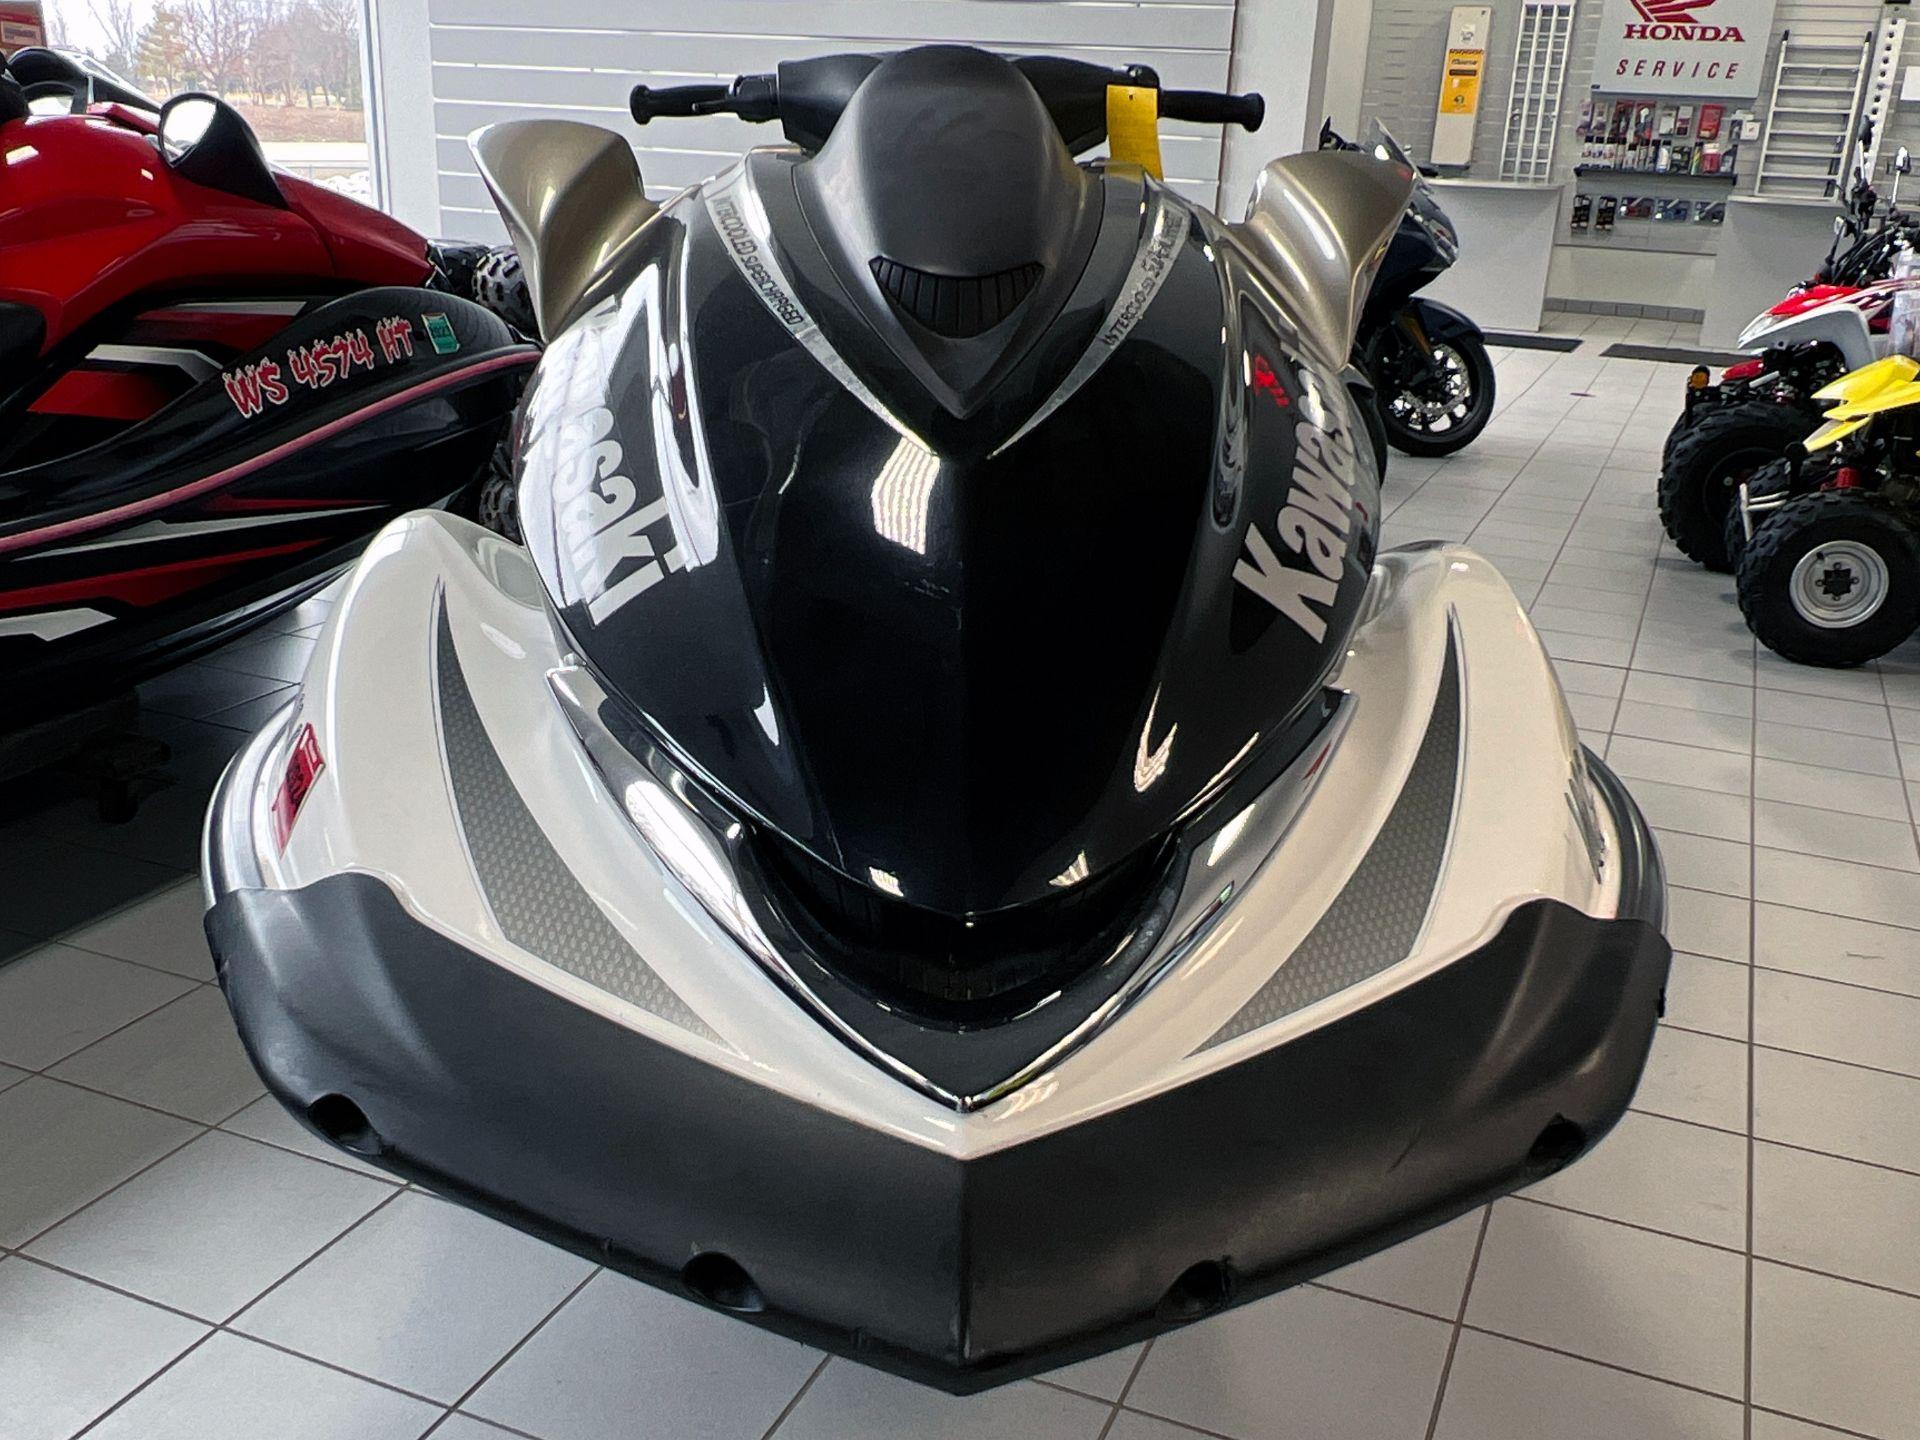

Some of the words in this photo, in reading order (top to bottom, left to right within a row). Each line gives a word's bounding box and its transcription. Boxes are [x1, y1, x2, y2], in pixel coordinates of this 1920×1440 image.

[1623, 24, 1745, 42] HONDA
[1616, 59, 1739, 79] SERVICE
[222, 357, 289, 419] WS
[287, 327, 374, 389] 4574
[376, 315, 412, 364] HT
